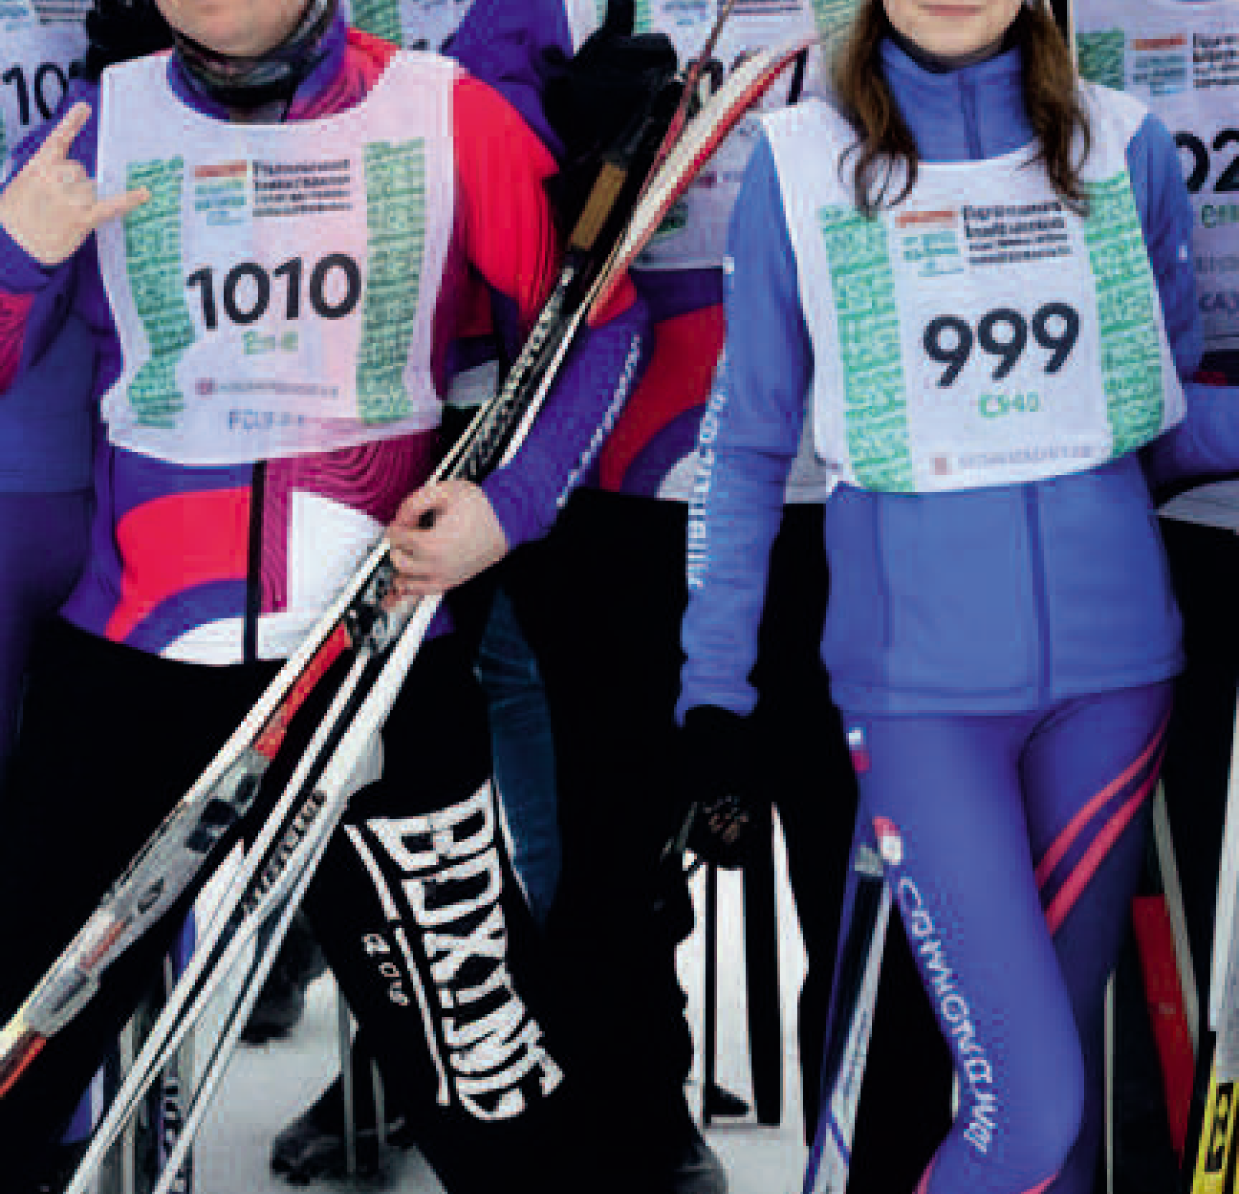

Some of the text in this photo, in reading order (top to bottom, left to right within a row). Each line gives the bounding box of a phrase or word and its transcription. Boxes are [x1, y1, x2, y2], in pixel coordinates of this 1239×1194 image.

[1, 62, 79, 126] 10
[186, 253, 361, 331] 1010
[922, 302, 1080, 387] 999
[365, 778, 565, 1122] BOXING
